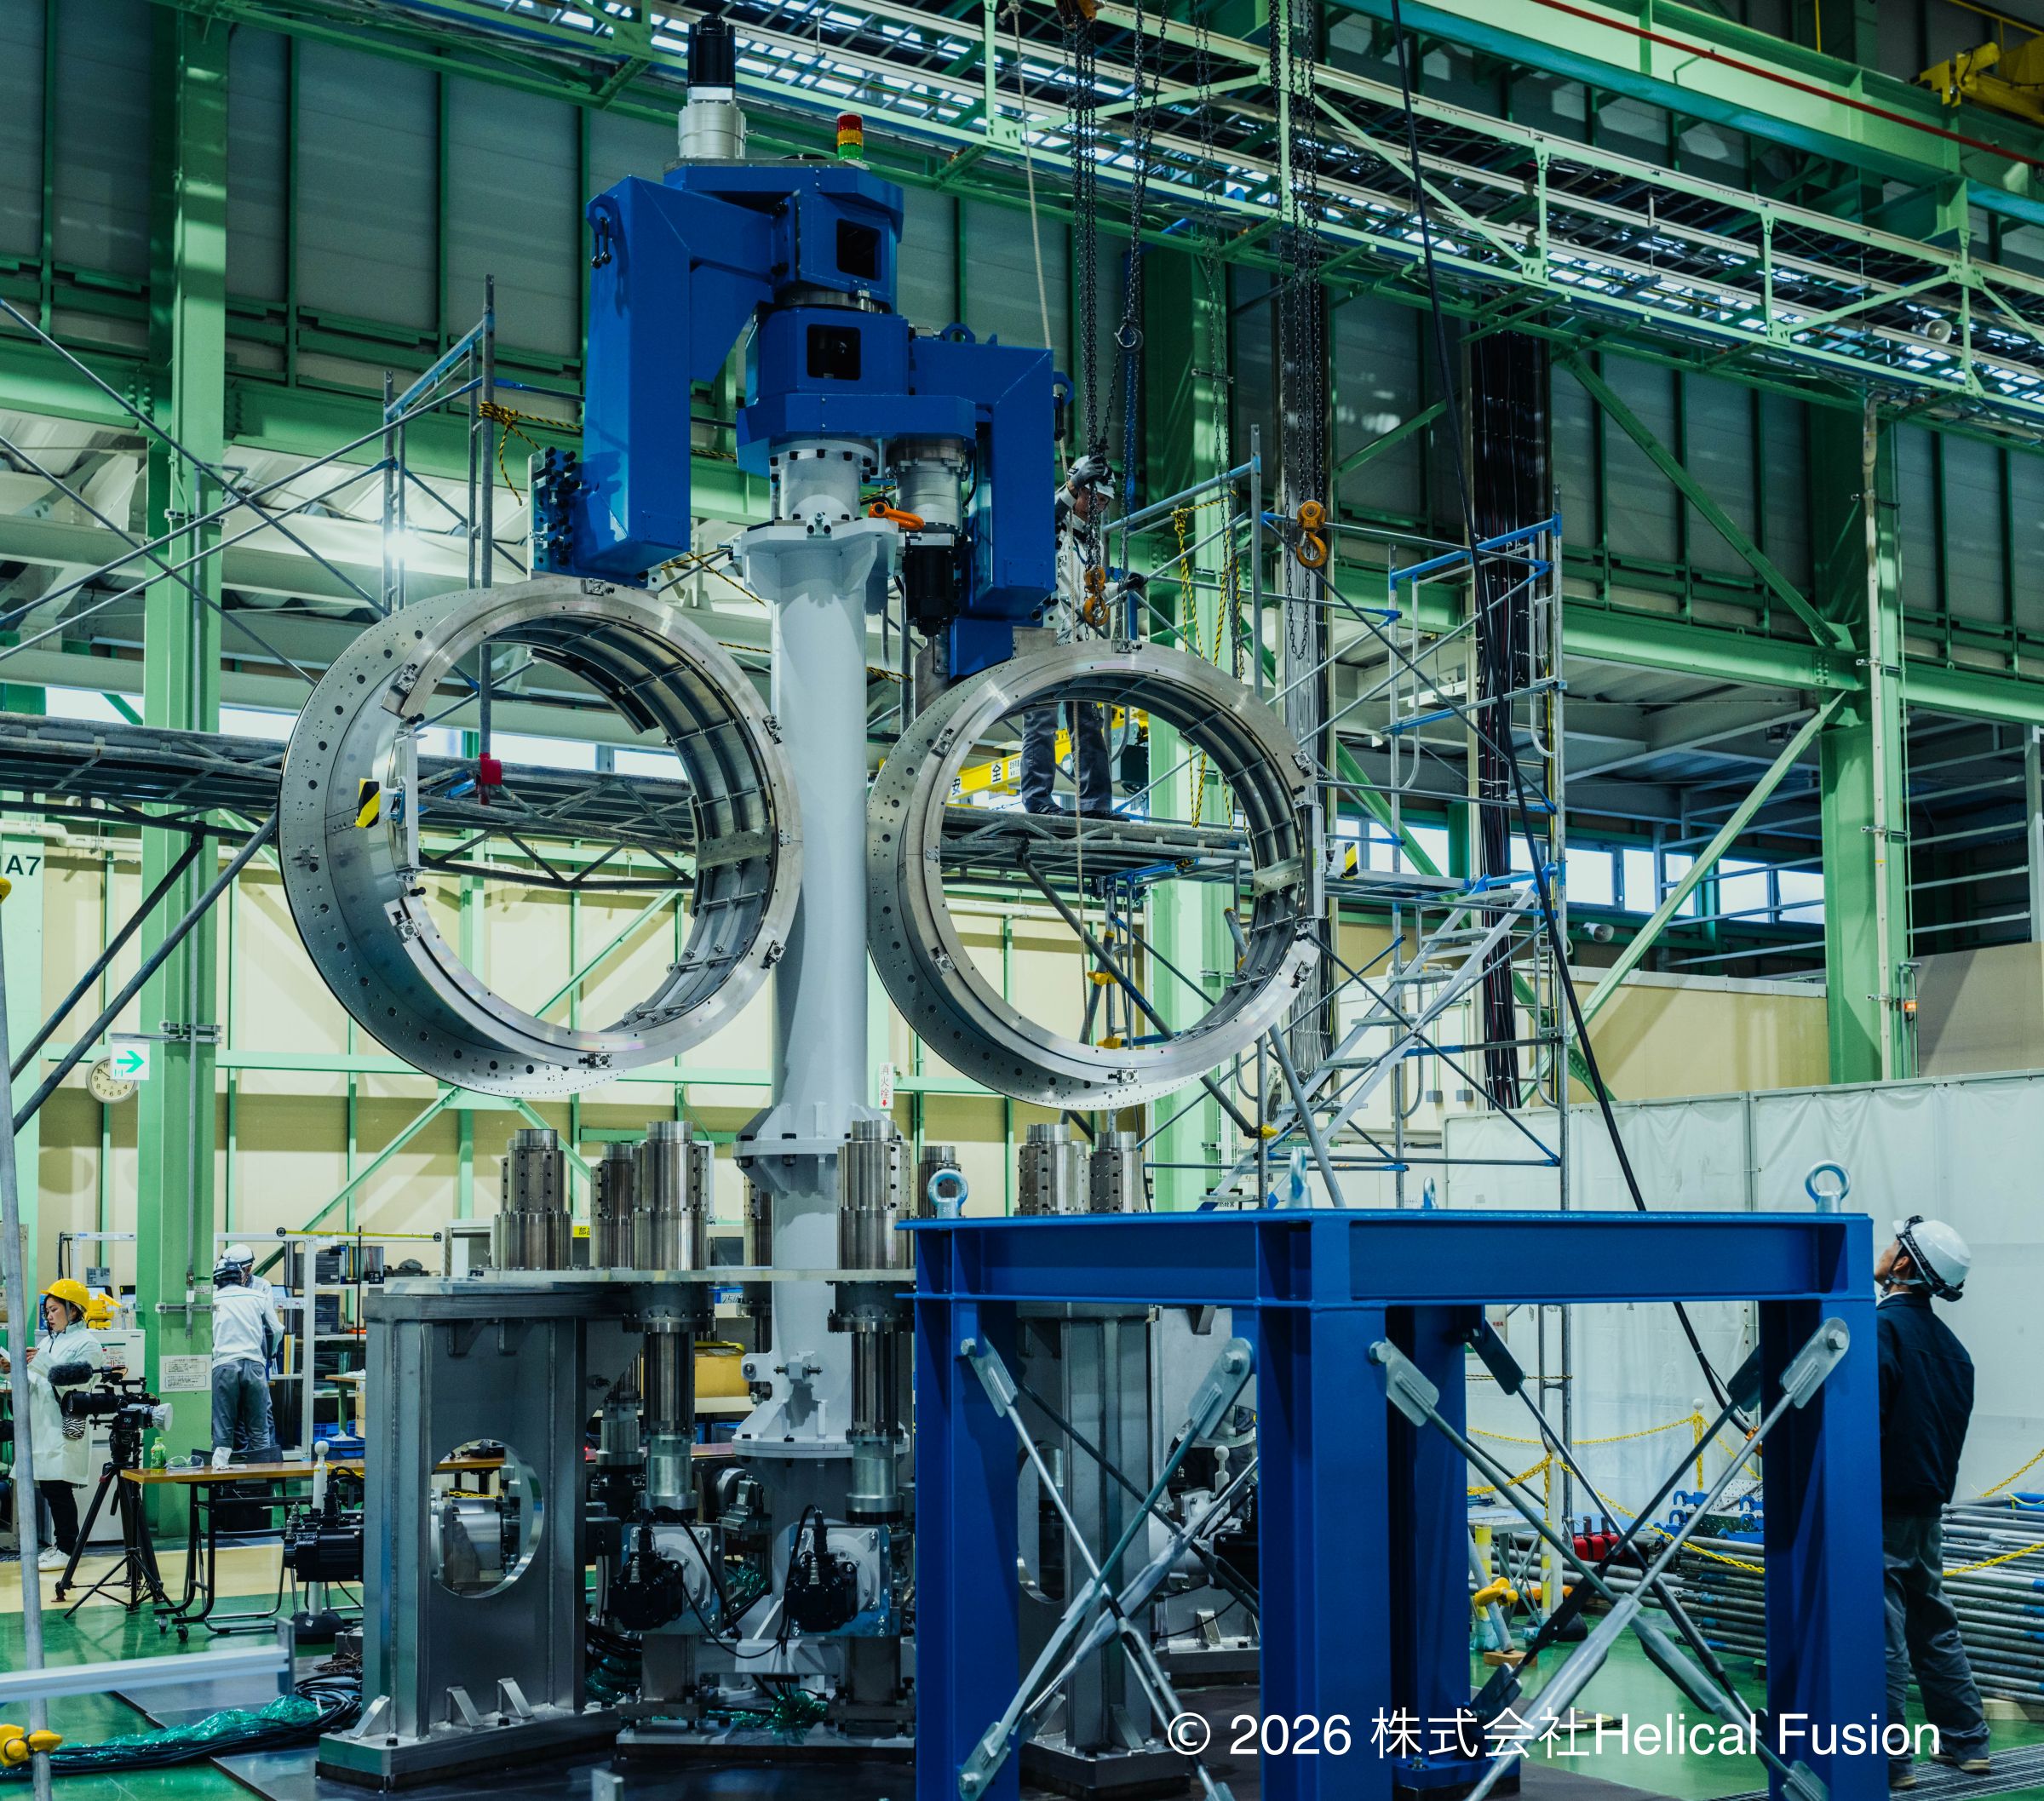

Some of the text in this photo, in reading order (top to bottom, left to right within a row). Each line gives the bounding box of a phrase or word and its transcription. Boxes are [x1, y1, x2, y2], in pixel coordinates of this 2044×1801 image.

[5, 855, 41, 876] A7
[881, 1064, 890, 1099] 消火栓
